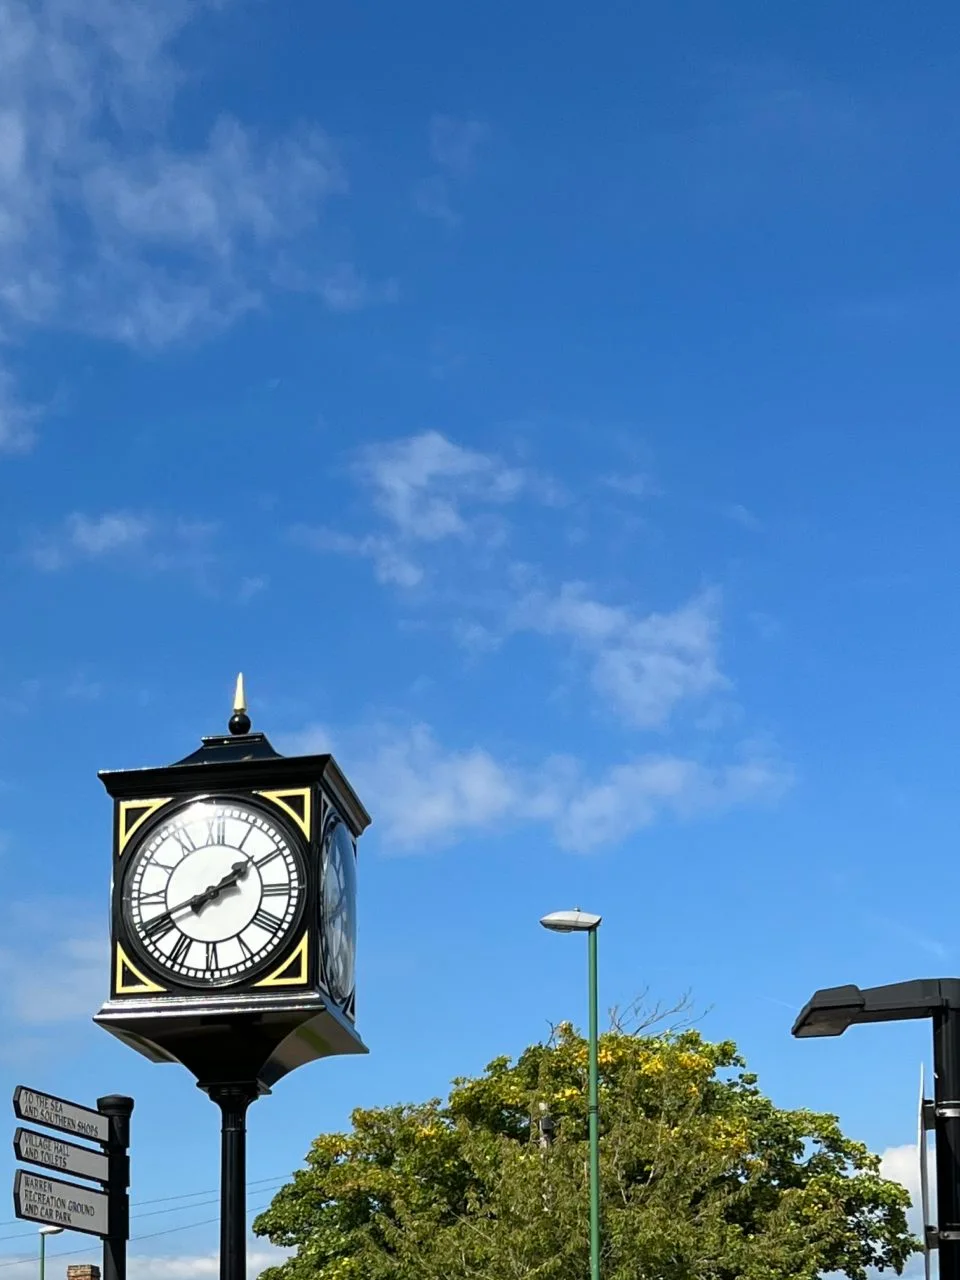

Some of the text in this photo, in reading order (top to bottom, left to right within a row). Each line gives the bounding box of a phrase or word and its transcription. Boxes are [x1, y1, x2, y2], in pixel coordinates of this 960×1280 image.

[262, 883, 290, 897] III
[25, 1091, 63, 1113] TO THE SEA
[24, 1104, 99, 1137] AND SOUTHERN SHOPS
[24, 1132, 70, 1157] VILLAGE HALL
[24, 1146, 67, 1168] AND TOILETS
[24, 1176, 53, 1193] WARREN
[24, 1189, 95, 1217] RECREATION GROUND
[24, 1203, 72, 1224] AND CAR PARK
